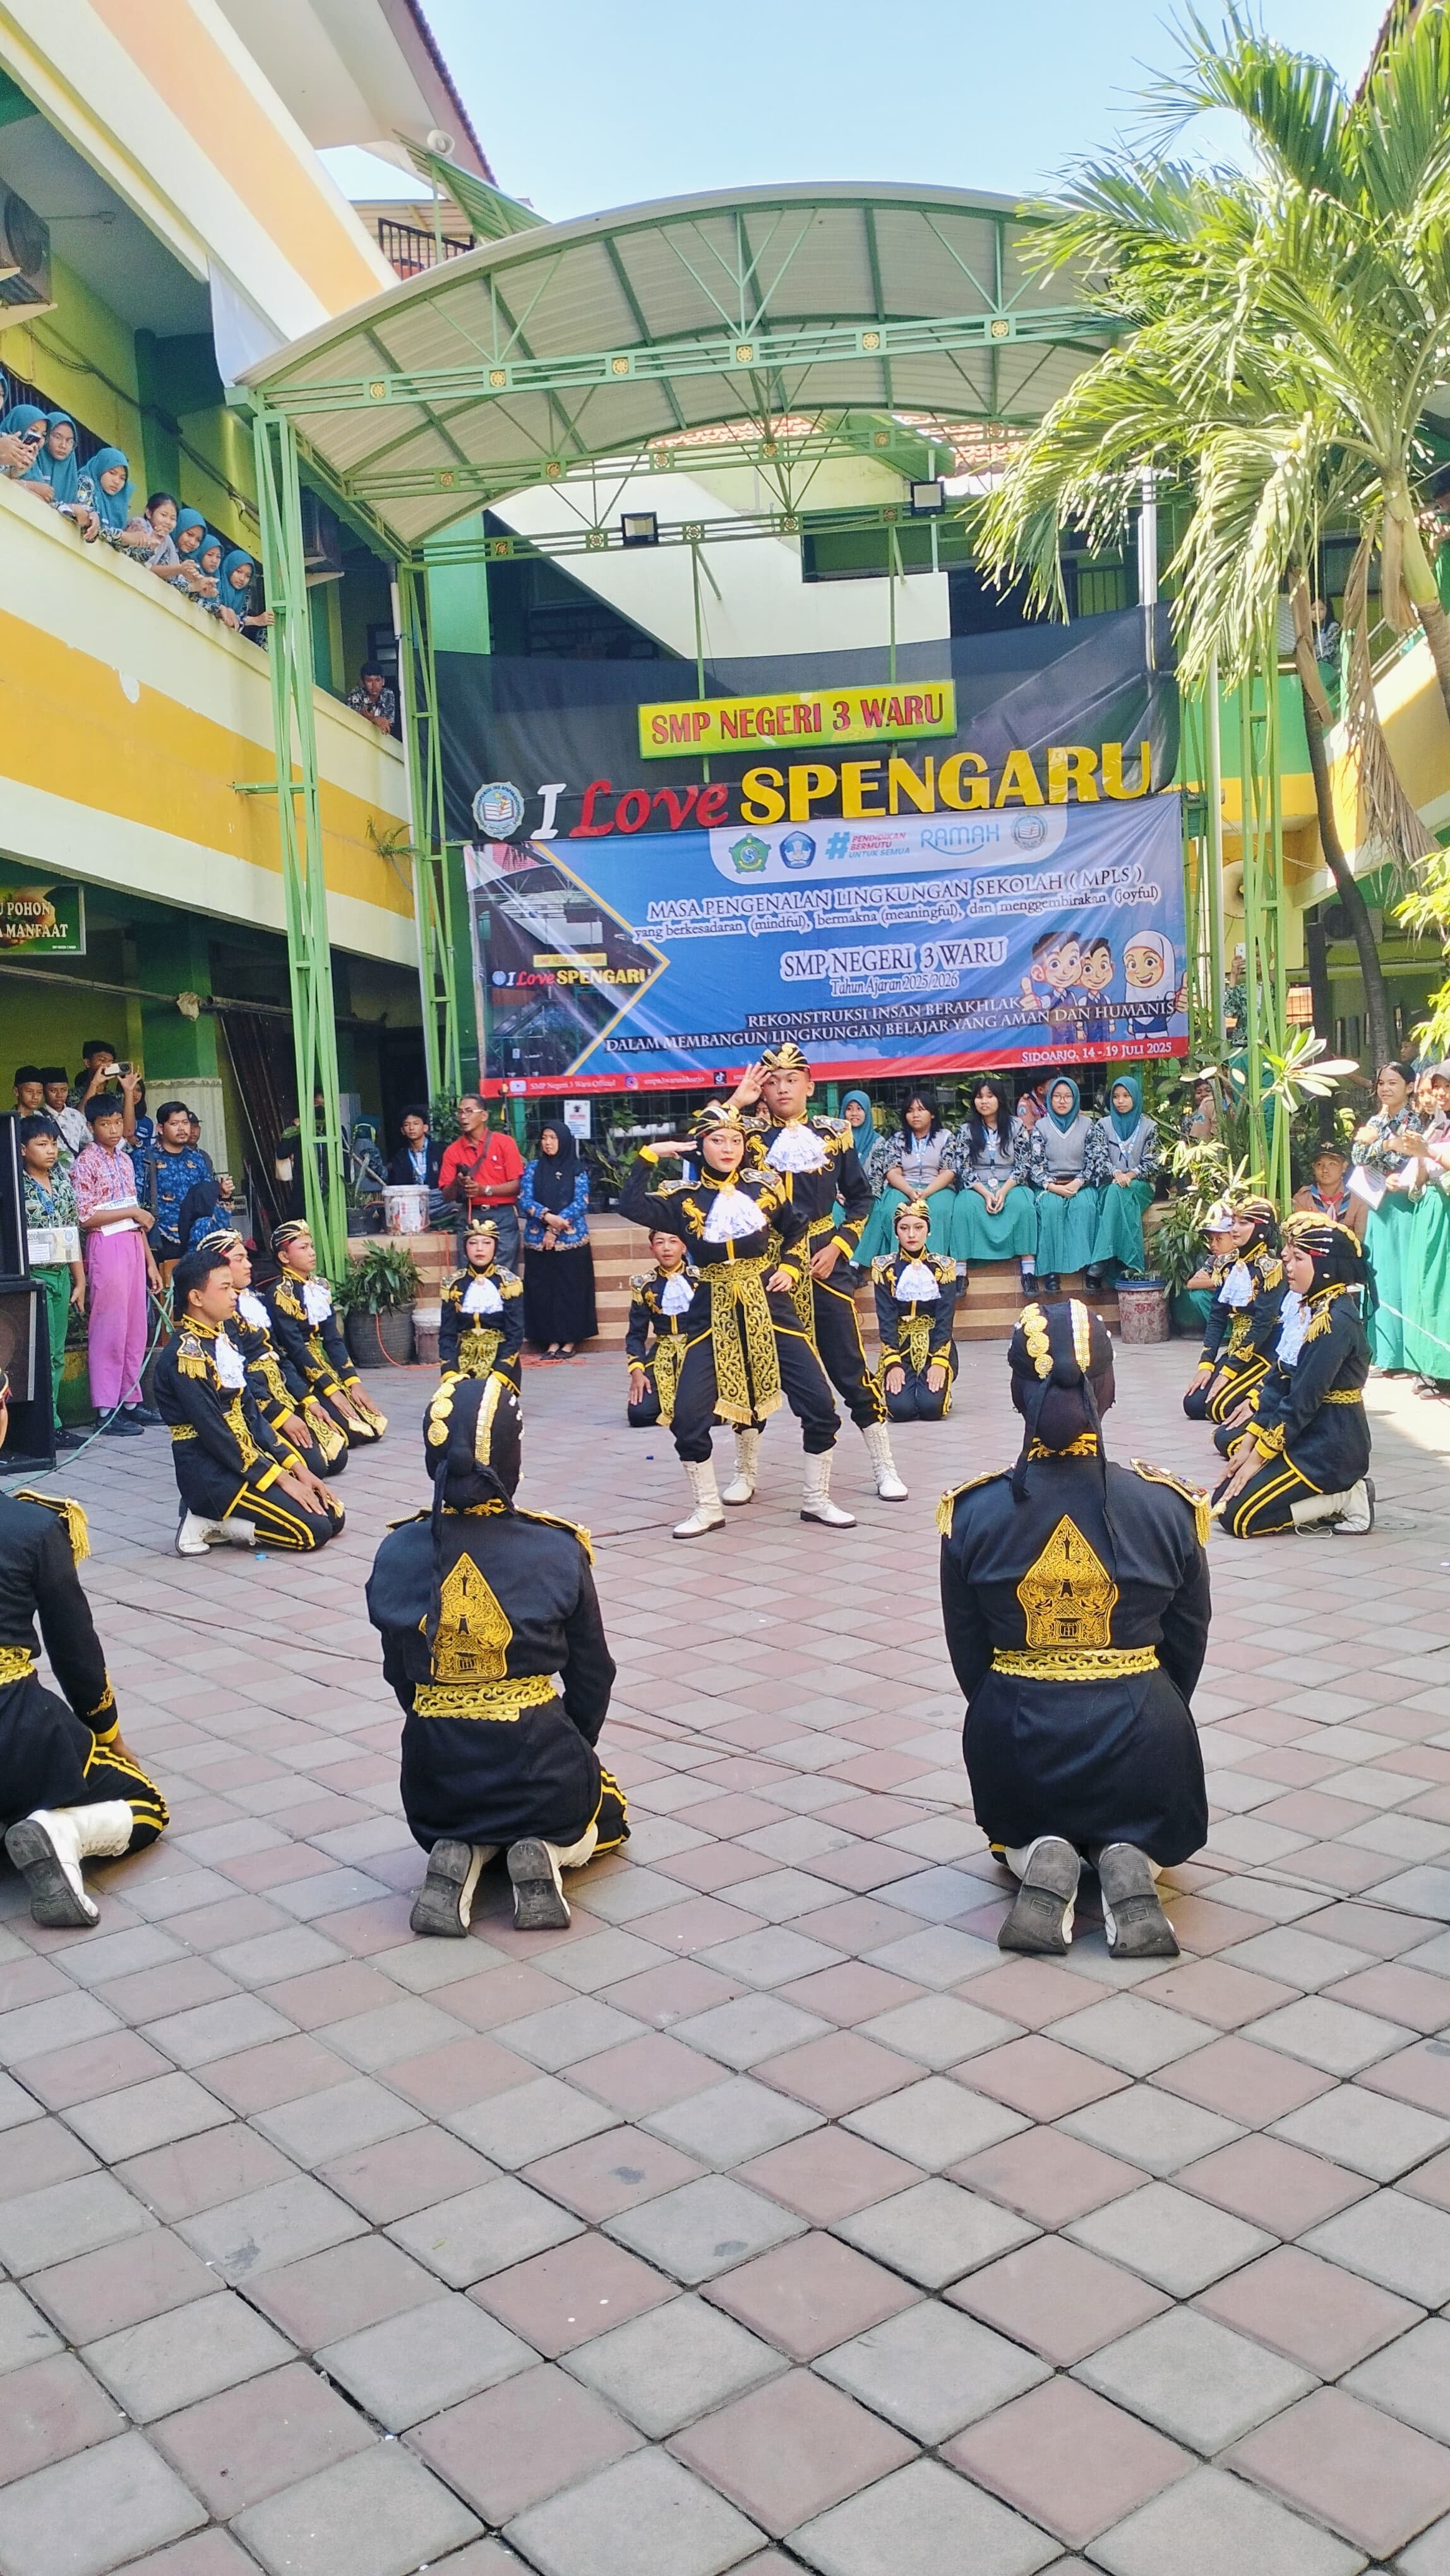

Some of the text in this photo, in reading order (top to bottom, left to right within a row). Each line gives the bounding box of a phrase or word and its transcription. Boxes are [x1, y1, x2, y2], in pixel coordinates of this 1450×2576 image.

[652, 693, 943, 744] SMP NEGERI 3 WARU
[530, 783, 567, 840] I
[568, 779, 728, 837] Love
[740, 741, 1151, 825] SPENGARU
[850, 841, 892, 850] BERMUTU
[852, 832, 906, 842] PENDIDIKAN
[921, 823, 999, 848] RAMAH
[849, 847, 909, 859] UNTUK SEMUA
[7, 902, 51, 915] POHON
[650, 902, 703, 919] MASA
[705, 891, 829, 915] PENGENALAN
[837, 882, 968, 906] LINGKUNGAN
[976, 876, 1062, 896] SEKOLAH
[635, 886, 1158, 941] yang berkesadaran (mindful), bermakna (meaningful), dan menggembirakan (joyful)
[6, 924, 68, 938] MANFAAT
[784, 941, 1005, 976] SMP NEGERI 3 WARU
[506, 972, 516, 986] I
[517, 971, 555, 986] Love
[831, 971, 958, 996] Tahun Ajaran 2025/2026
[748, 996, 1021, 1028] REKONSTRUKSI INSAN BERAKHLAK
[606, 1001, 1174, 1052] DALAM MEMBANGUN LINGKUNGAN BELAJAR YANG AMAN DAN HUMANIS
[1022, 1049, 1079, 1063] SIDOARJO,
[1083, 1047, 1095, 1058] 14
[1106, 1046, 1118, 1057] 19
[1122, 1044, 1144, 1058] JULI
[1147, 1042, 1171, 1054] 2025
